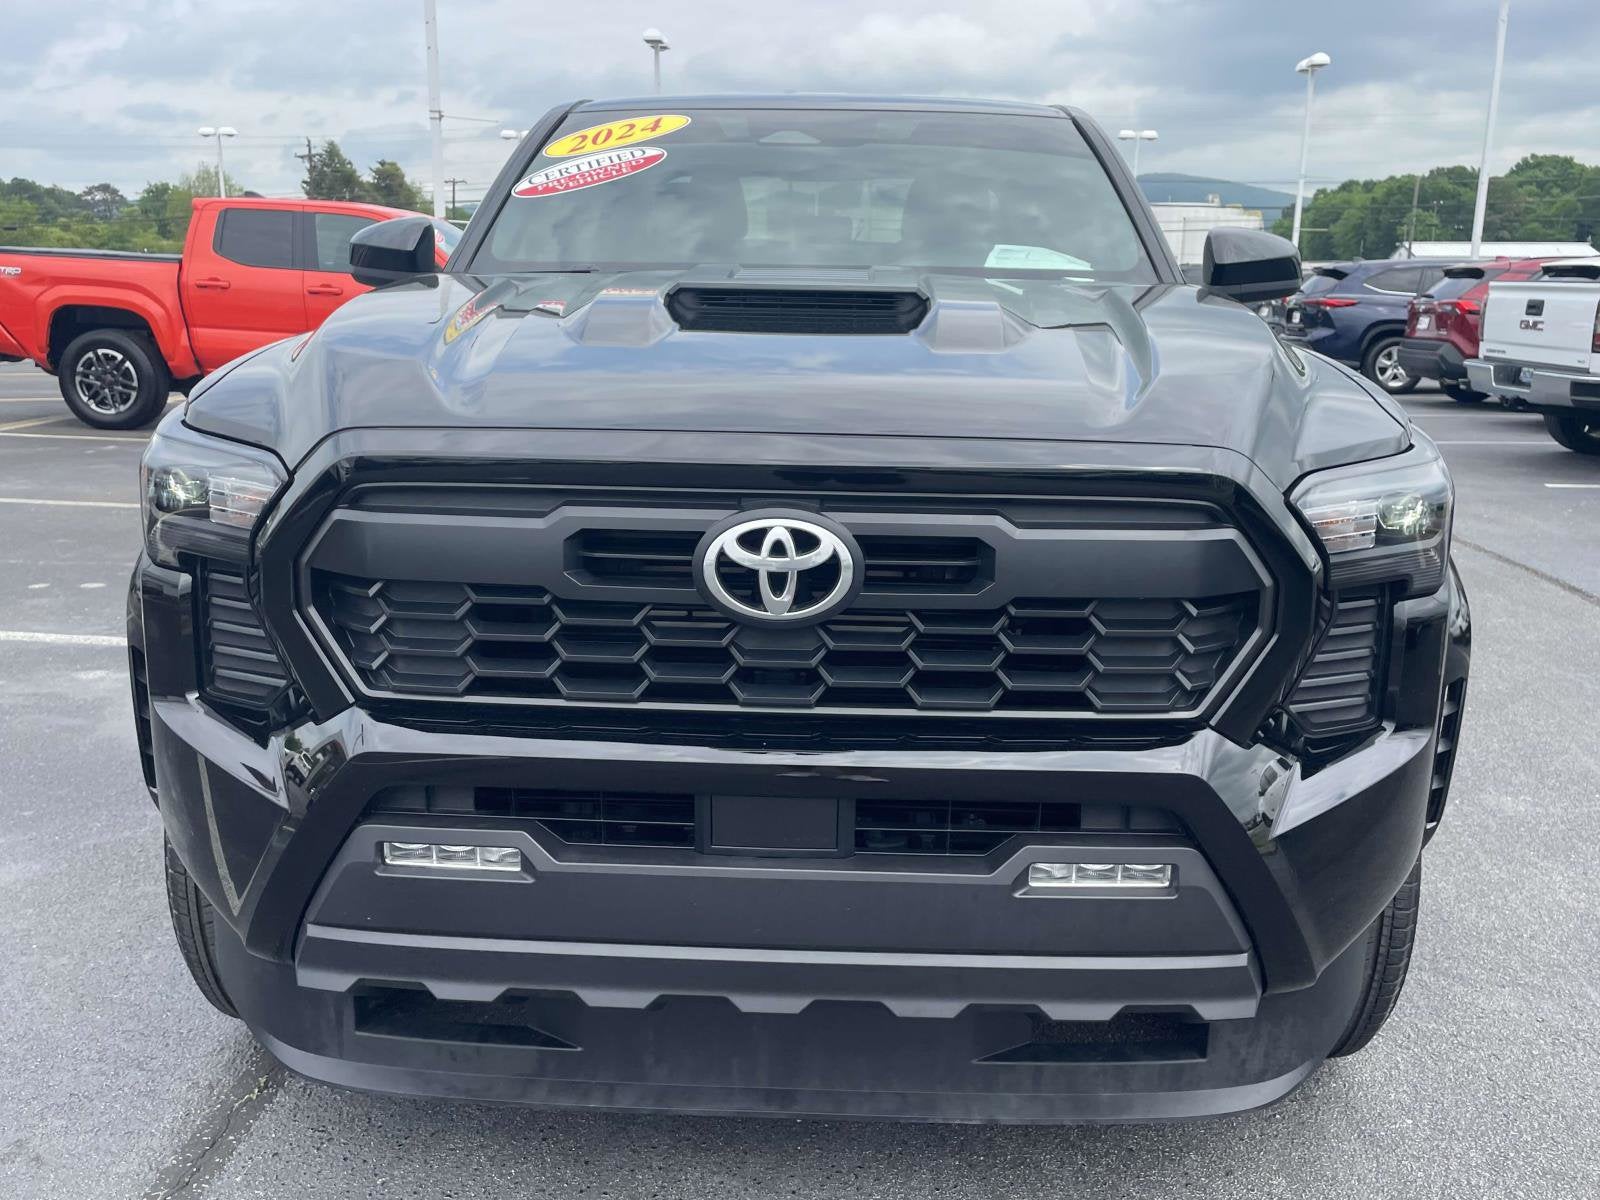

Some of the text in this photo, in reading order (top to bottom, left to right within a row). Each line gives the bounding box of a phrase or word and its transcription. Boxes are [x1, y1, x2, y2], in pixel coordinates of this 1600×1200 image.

[567, 117, 663, 154] 2024
[528, 148, 647, 185] CERTIFIED
[537, 158, 645, 191] PRE-OWNED
[554, 166, 633, 190] VEHICLE
[1520, 319, 1544, 331] GMC
